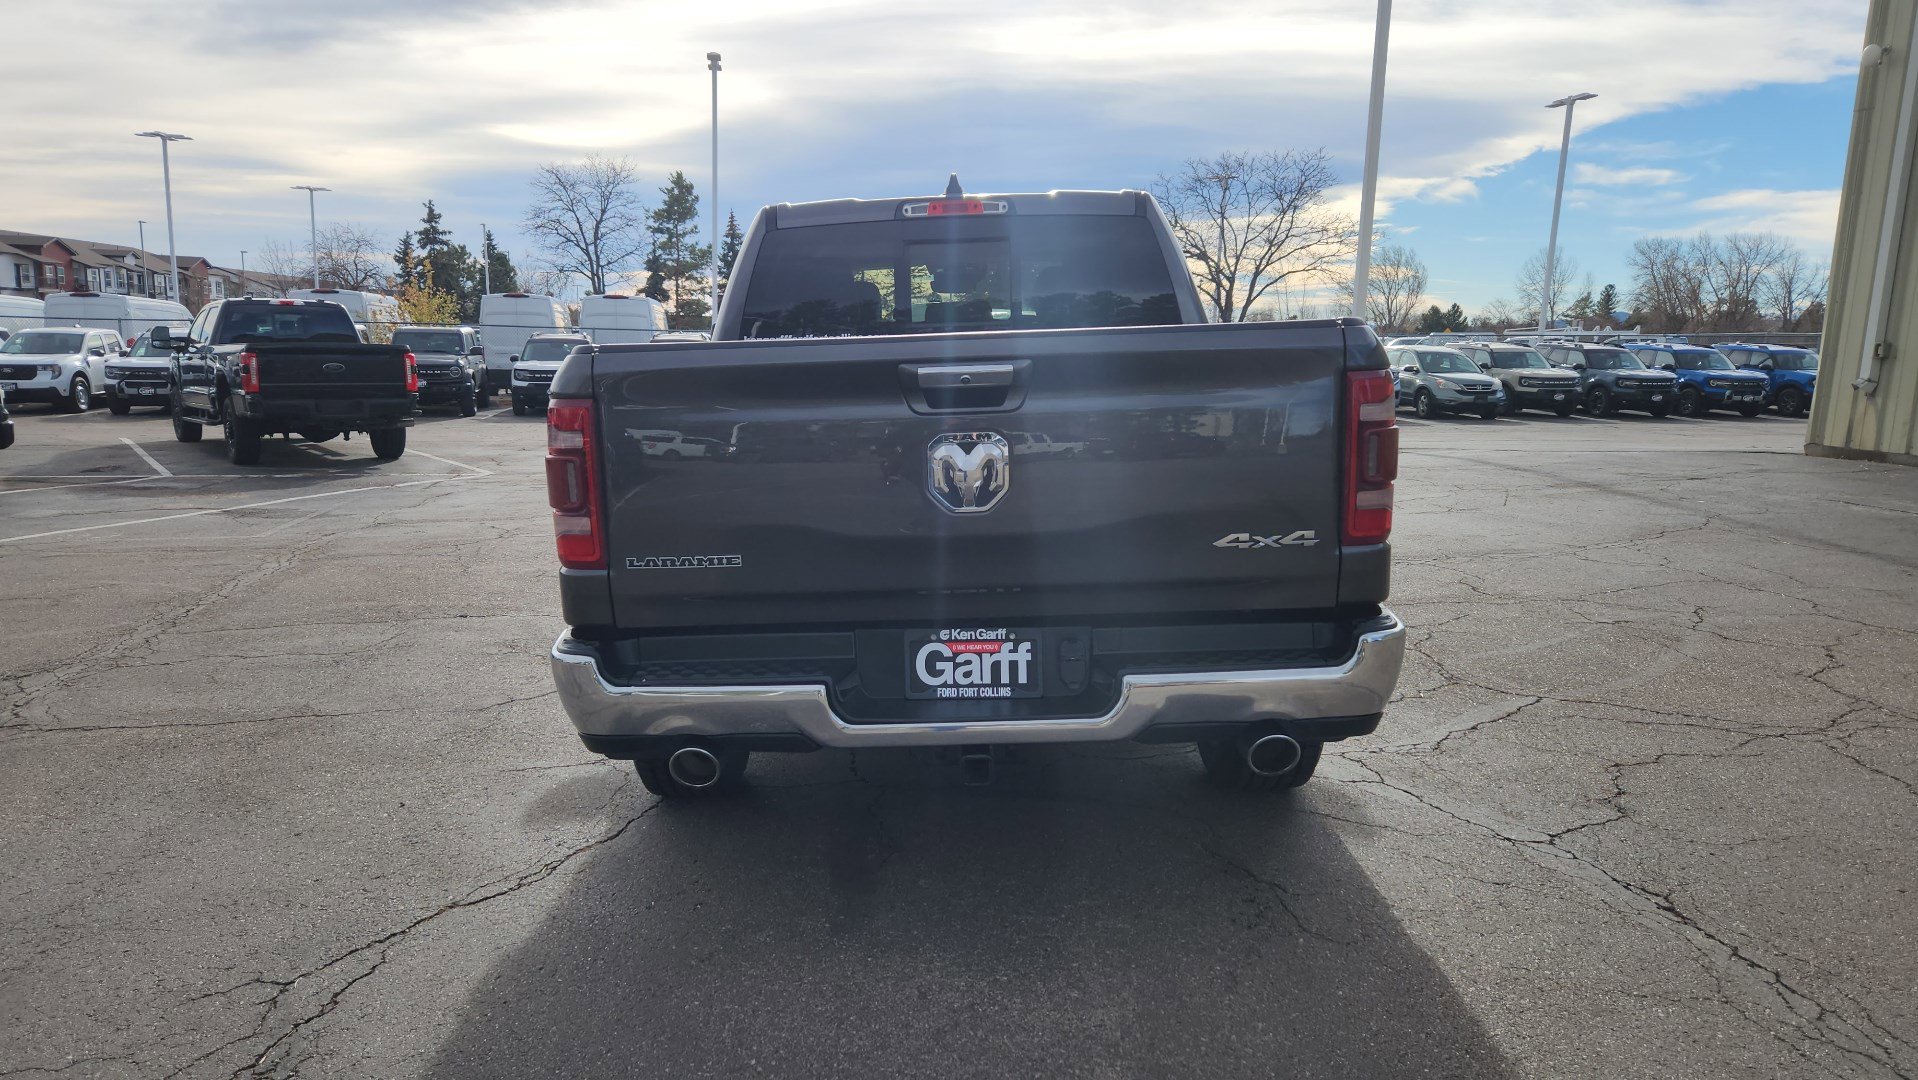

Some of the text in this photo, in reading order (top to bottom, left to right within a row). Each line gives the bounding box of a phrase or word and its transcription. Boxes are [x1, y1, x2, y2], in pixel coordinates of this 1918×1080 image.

[626, 555, 742, 569] LARAMIE
[951, 628, 1007, 640] Ken Garff
[915, 641, 1032, 686] Garff
[937, 686, 1012, 698] FORD FORT COLLINS
